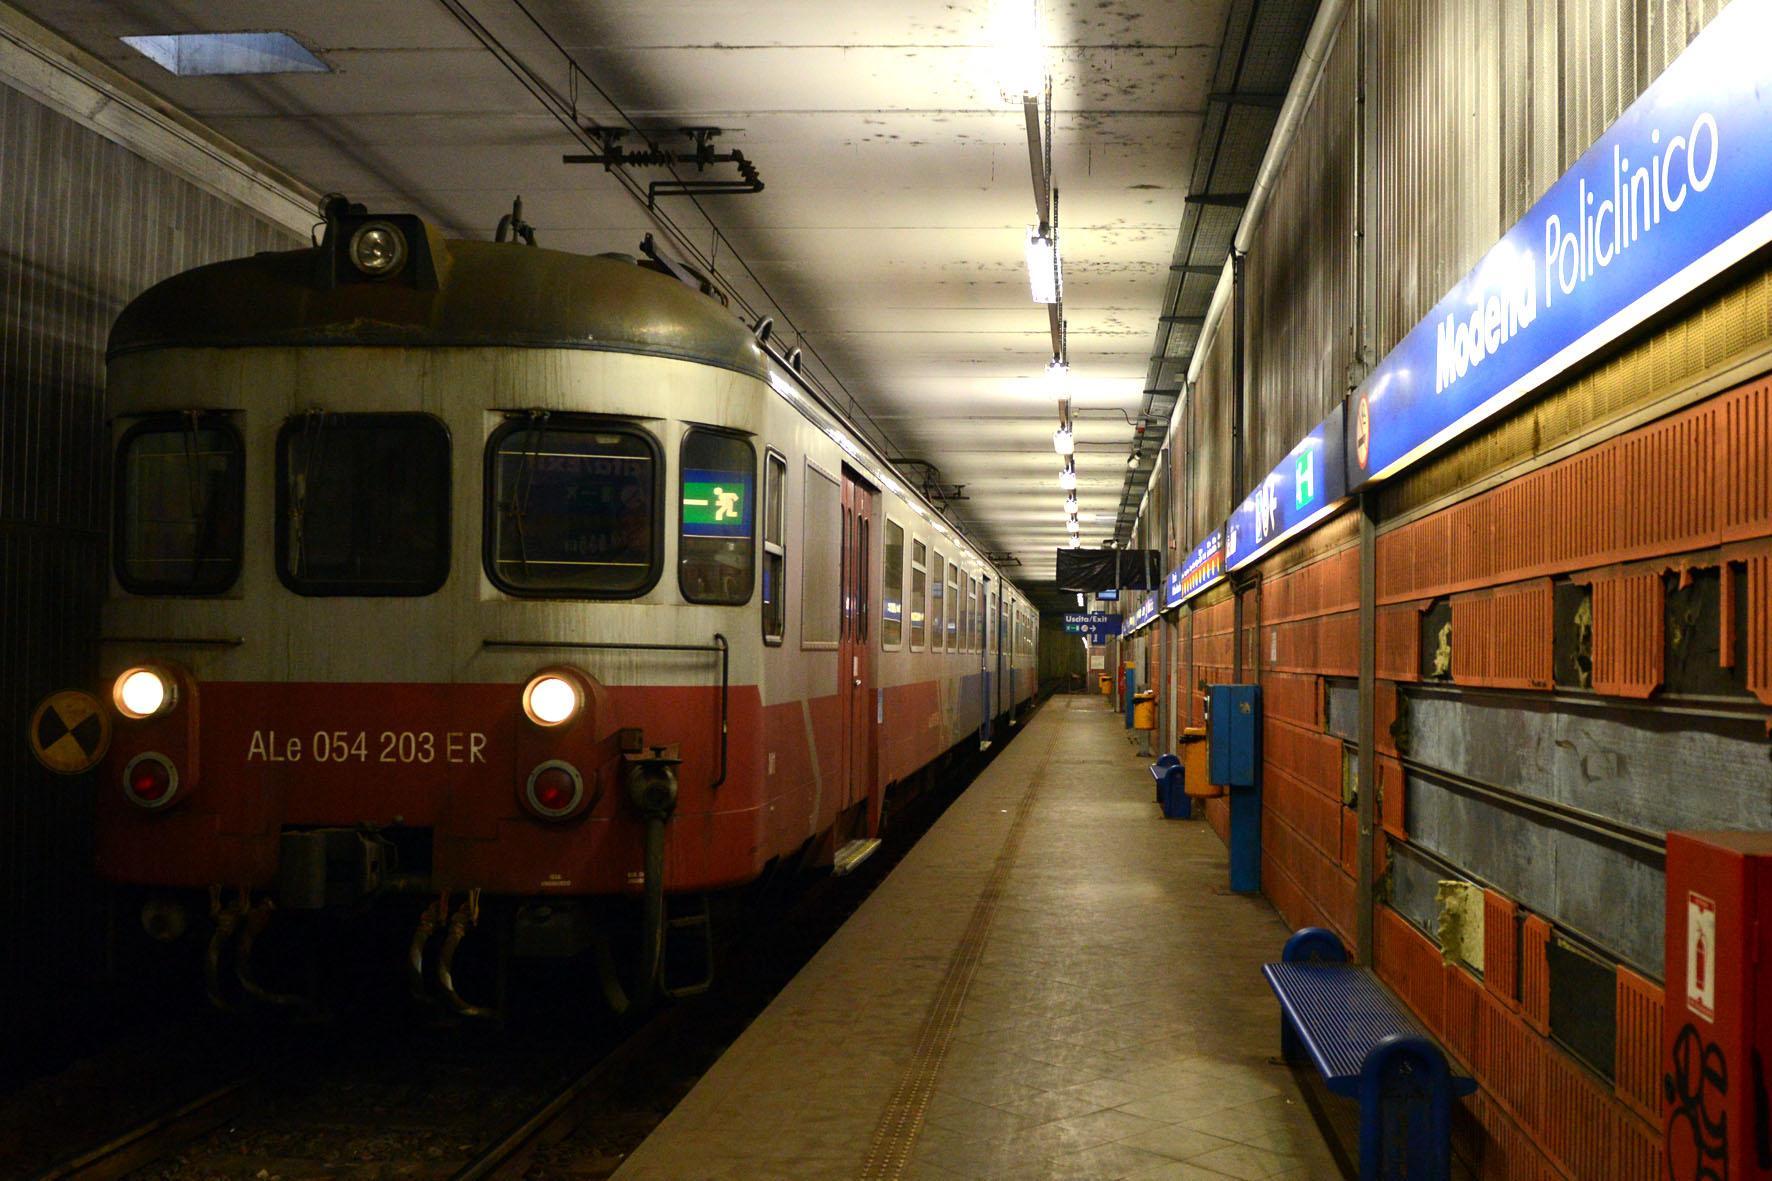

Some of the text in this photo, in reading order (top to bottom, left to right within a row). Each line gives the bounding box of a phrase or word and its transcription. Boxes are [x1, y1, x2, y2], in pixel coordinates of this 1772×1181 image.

[1545, 112, 1719, 308] Policlinico
[1065, 615, 1107, 623] Uscita/Exit
[248, 730, 488, 764] ALe 054 203 ER
